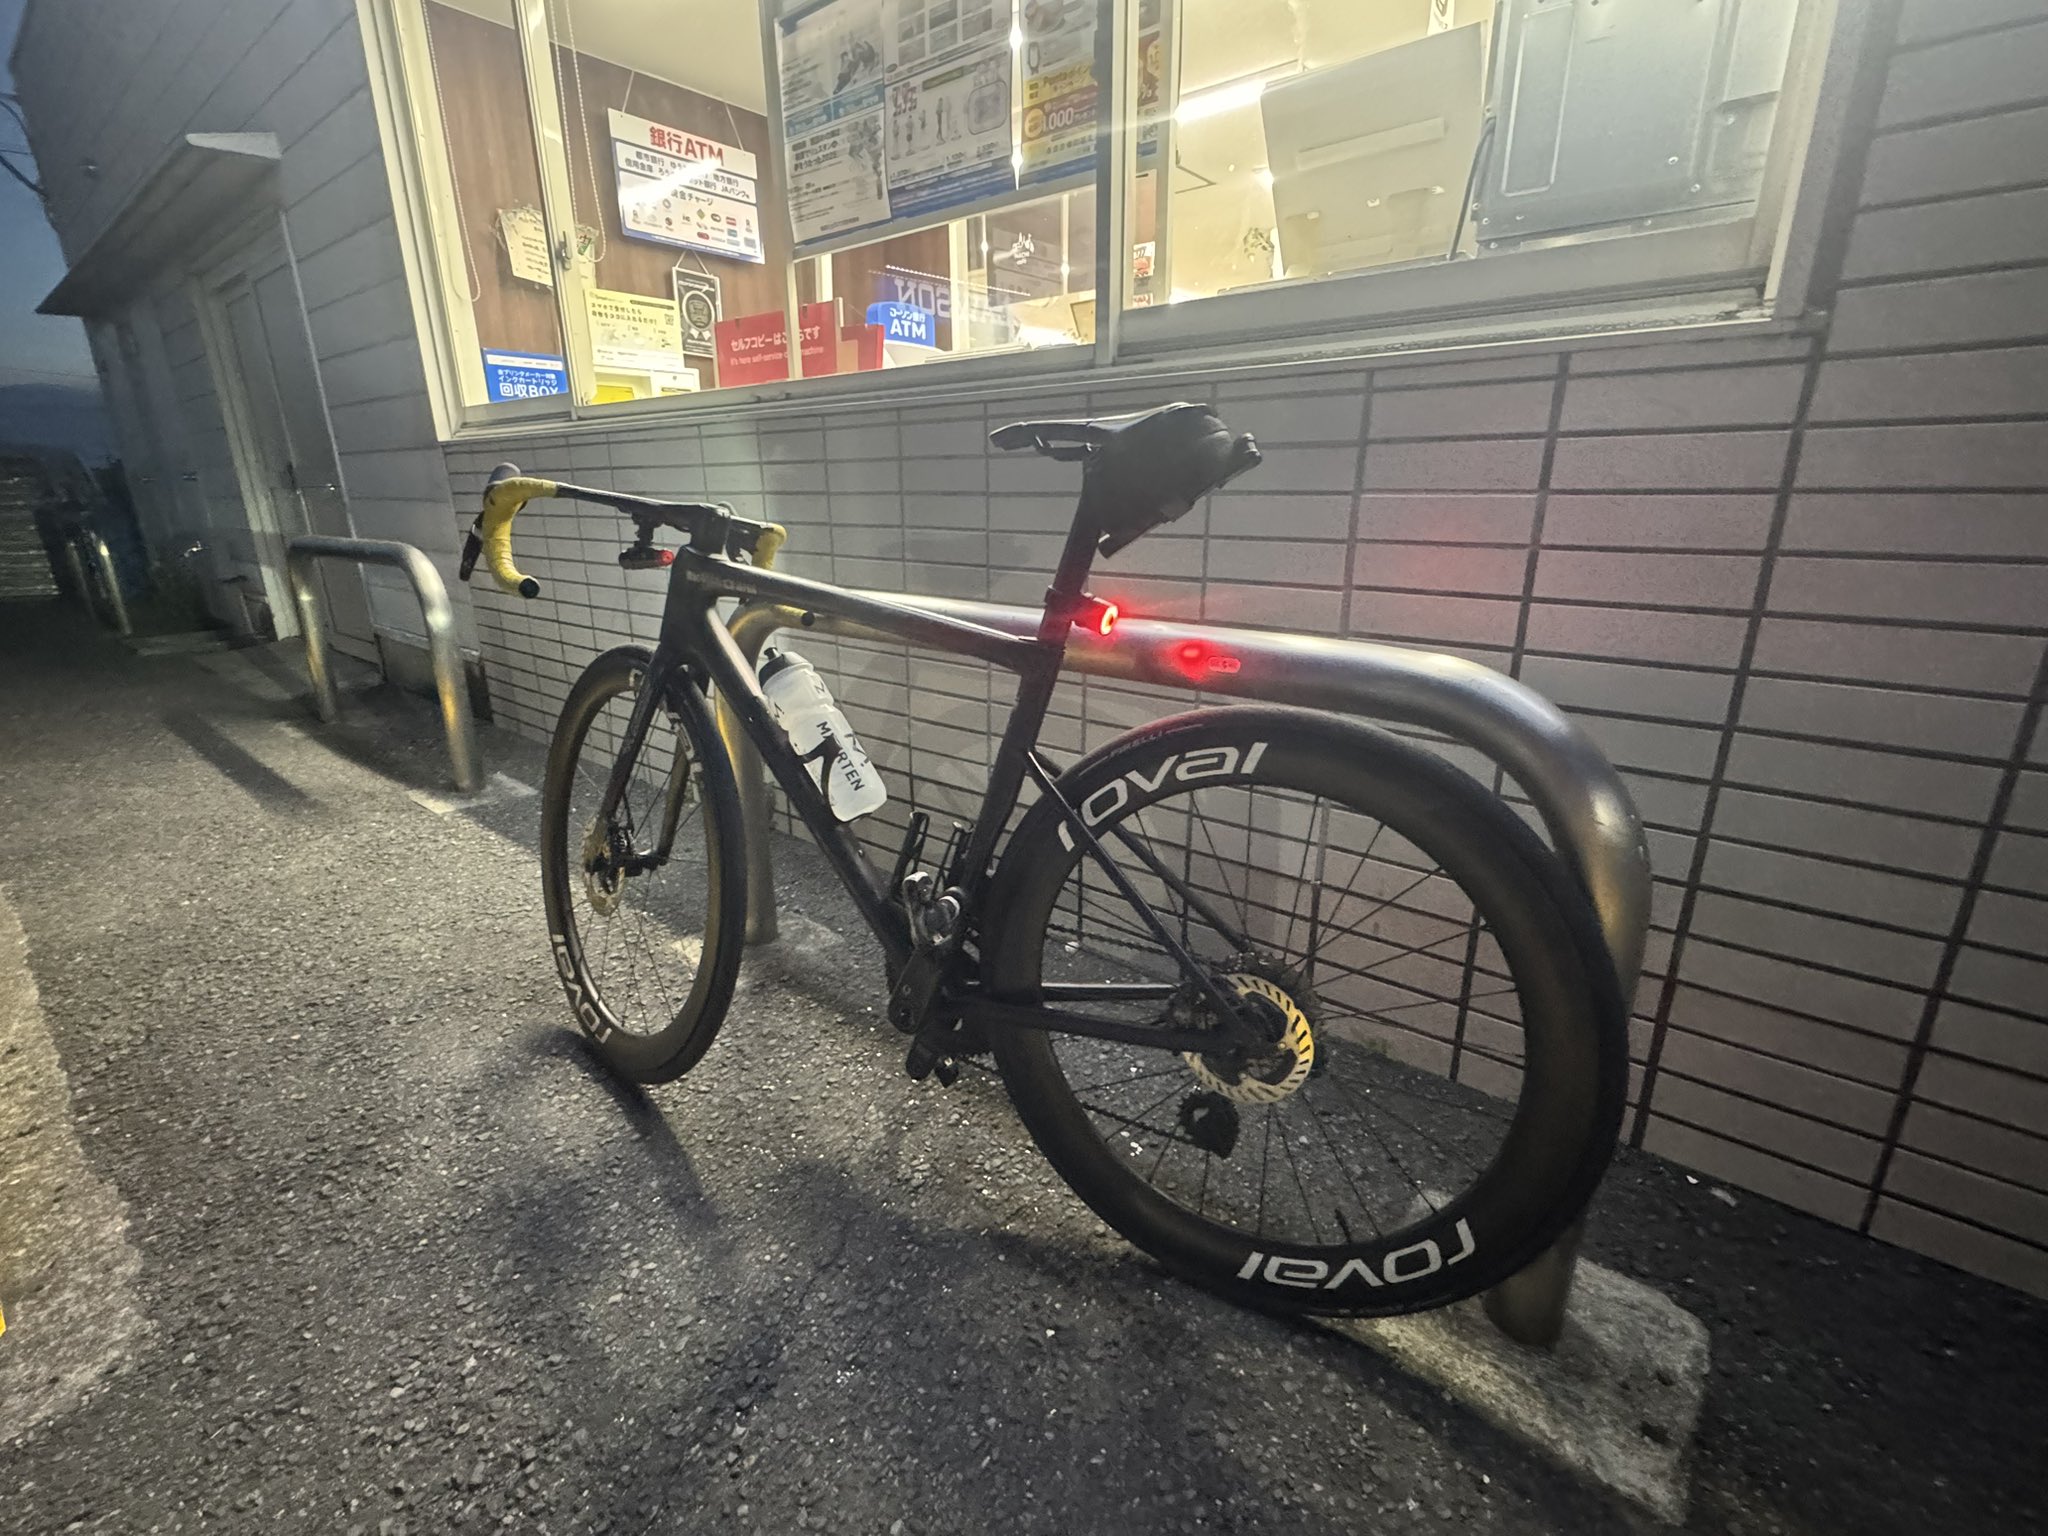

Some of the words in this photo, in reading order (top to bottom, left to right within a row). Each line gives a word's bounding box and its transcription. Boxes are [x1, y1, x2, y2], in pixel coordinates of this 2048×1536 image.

[649, 126, 724, 167] 銀行ATM
[635, 150, 665, 168] 都市銀行
[889, 307, 926, 323] ローソン銀行
[889, 319, 927, 341] ATM
[499, 382, 559, 398] 回収BOX
[815, 720, 866, 793] MRTEN
[1236, 1217, 1476, 1290] roval
